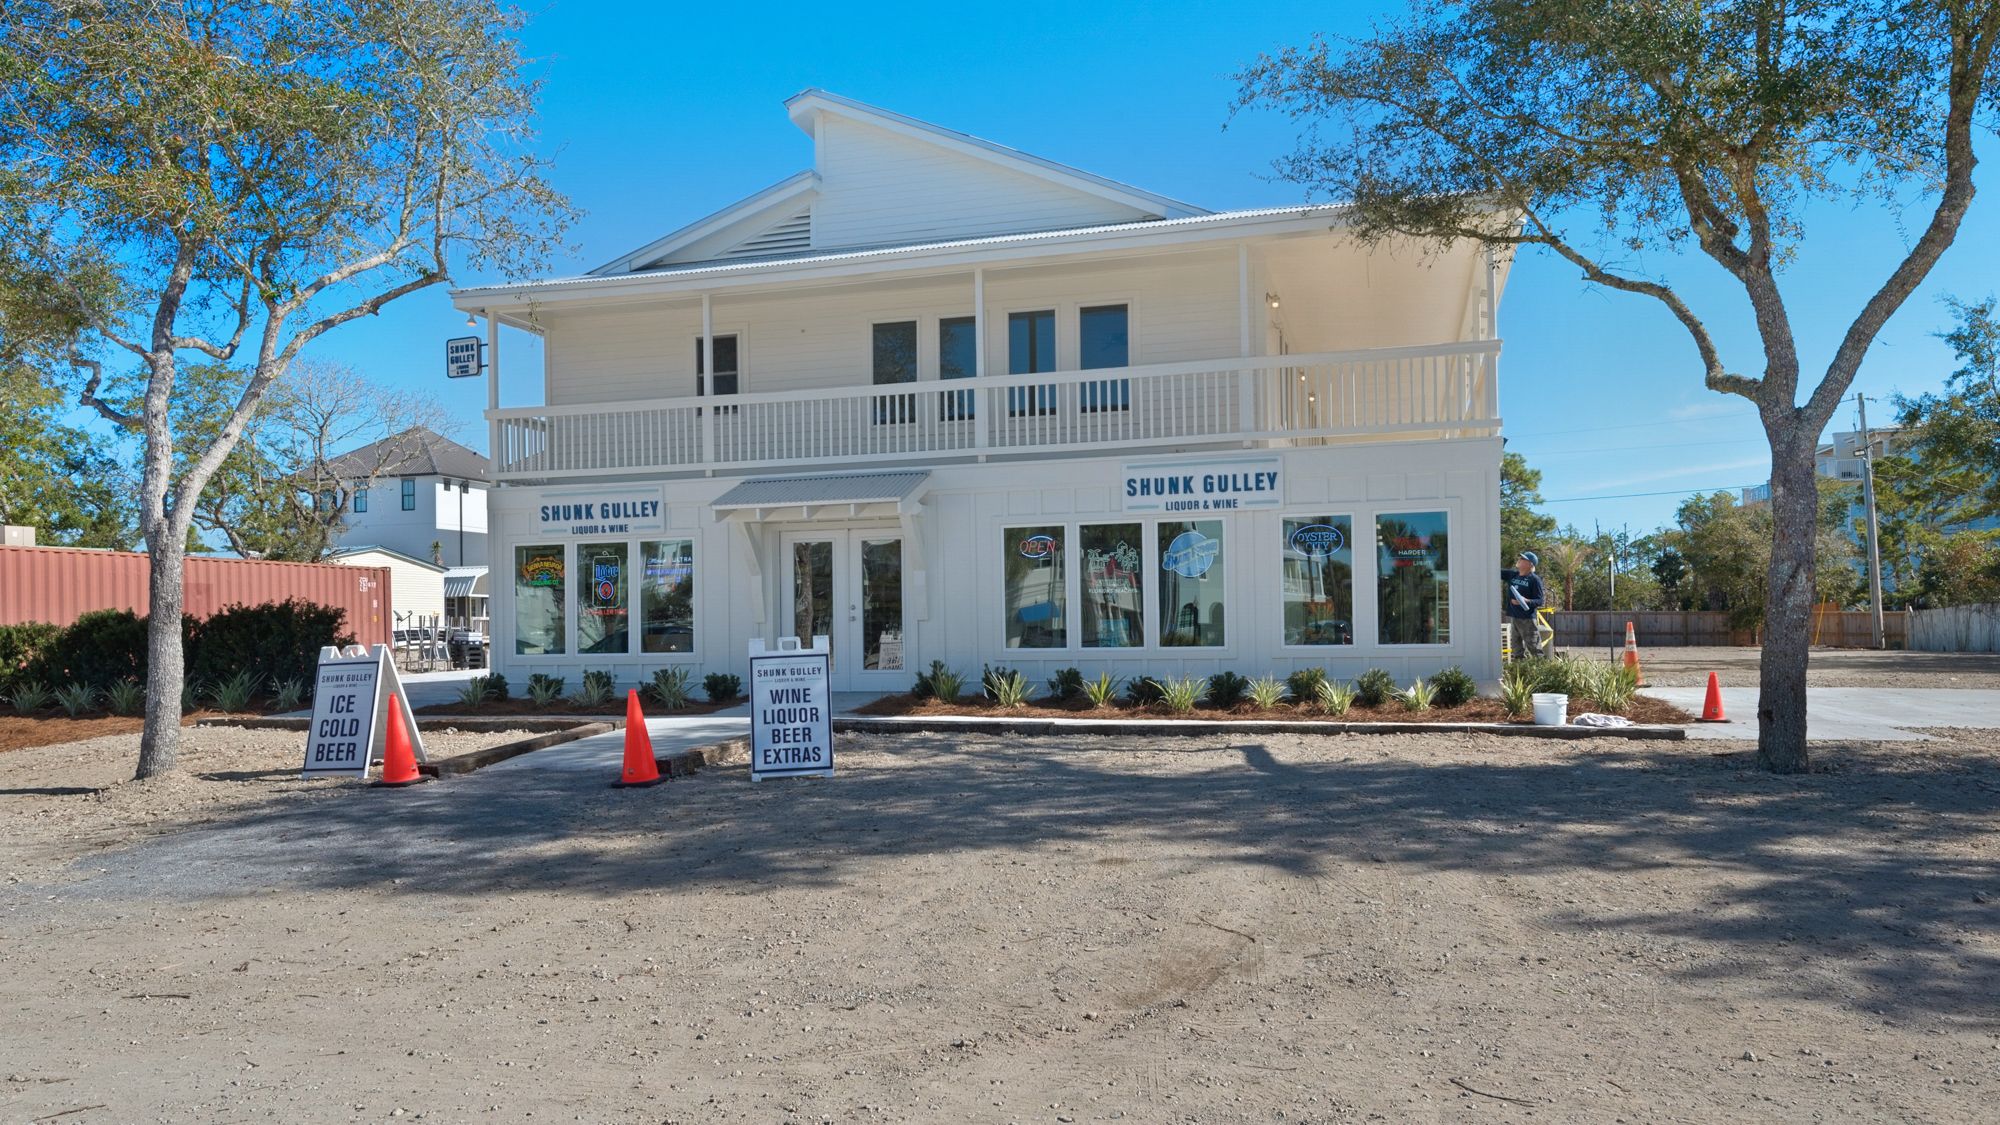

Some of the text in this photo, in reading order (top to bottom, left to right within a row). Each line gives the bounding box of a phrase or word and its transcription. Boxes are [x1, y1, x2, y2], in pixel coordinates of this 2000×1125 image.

[450, 343, 475, 354] SHUNK
[450, 354, 475, 364] GULLEY
[1126, 472, 1278, 497] SHUNK GULLEY
[541, 501, 658, 522] SHUNK GULLEY
[1165, 499, 1238, 511] LIQUOR & WINE
[572, 524, 629, 535] LIQUOR & WINE
[1297, 532, 1337, 541] OYSTER
[1020, 540, 1056, 552] OPEN
[1306, 541, 1330, 550] CITY
[596, 565, 618, 581] Lite
[321, 673, 373, 683] SHUNK GULLEY
[757, 667, 822, 677] SHUNK GULLEY
[329, 695, 356, 713] ICE
[770, 688, 811, 704] WINE
[763, 707, 819, 725] LIQUOR
[319, 718, 360, 738] COLD
[772, 727, 812, 744] BEER
[315, 743, 357, 762] BEER
[763, 746, 822, 765] EXTRAS
